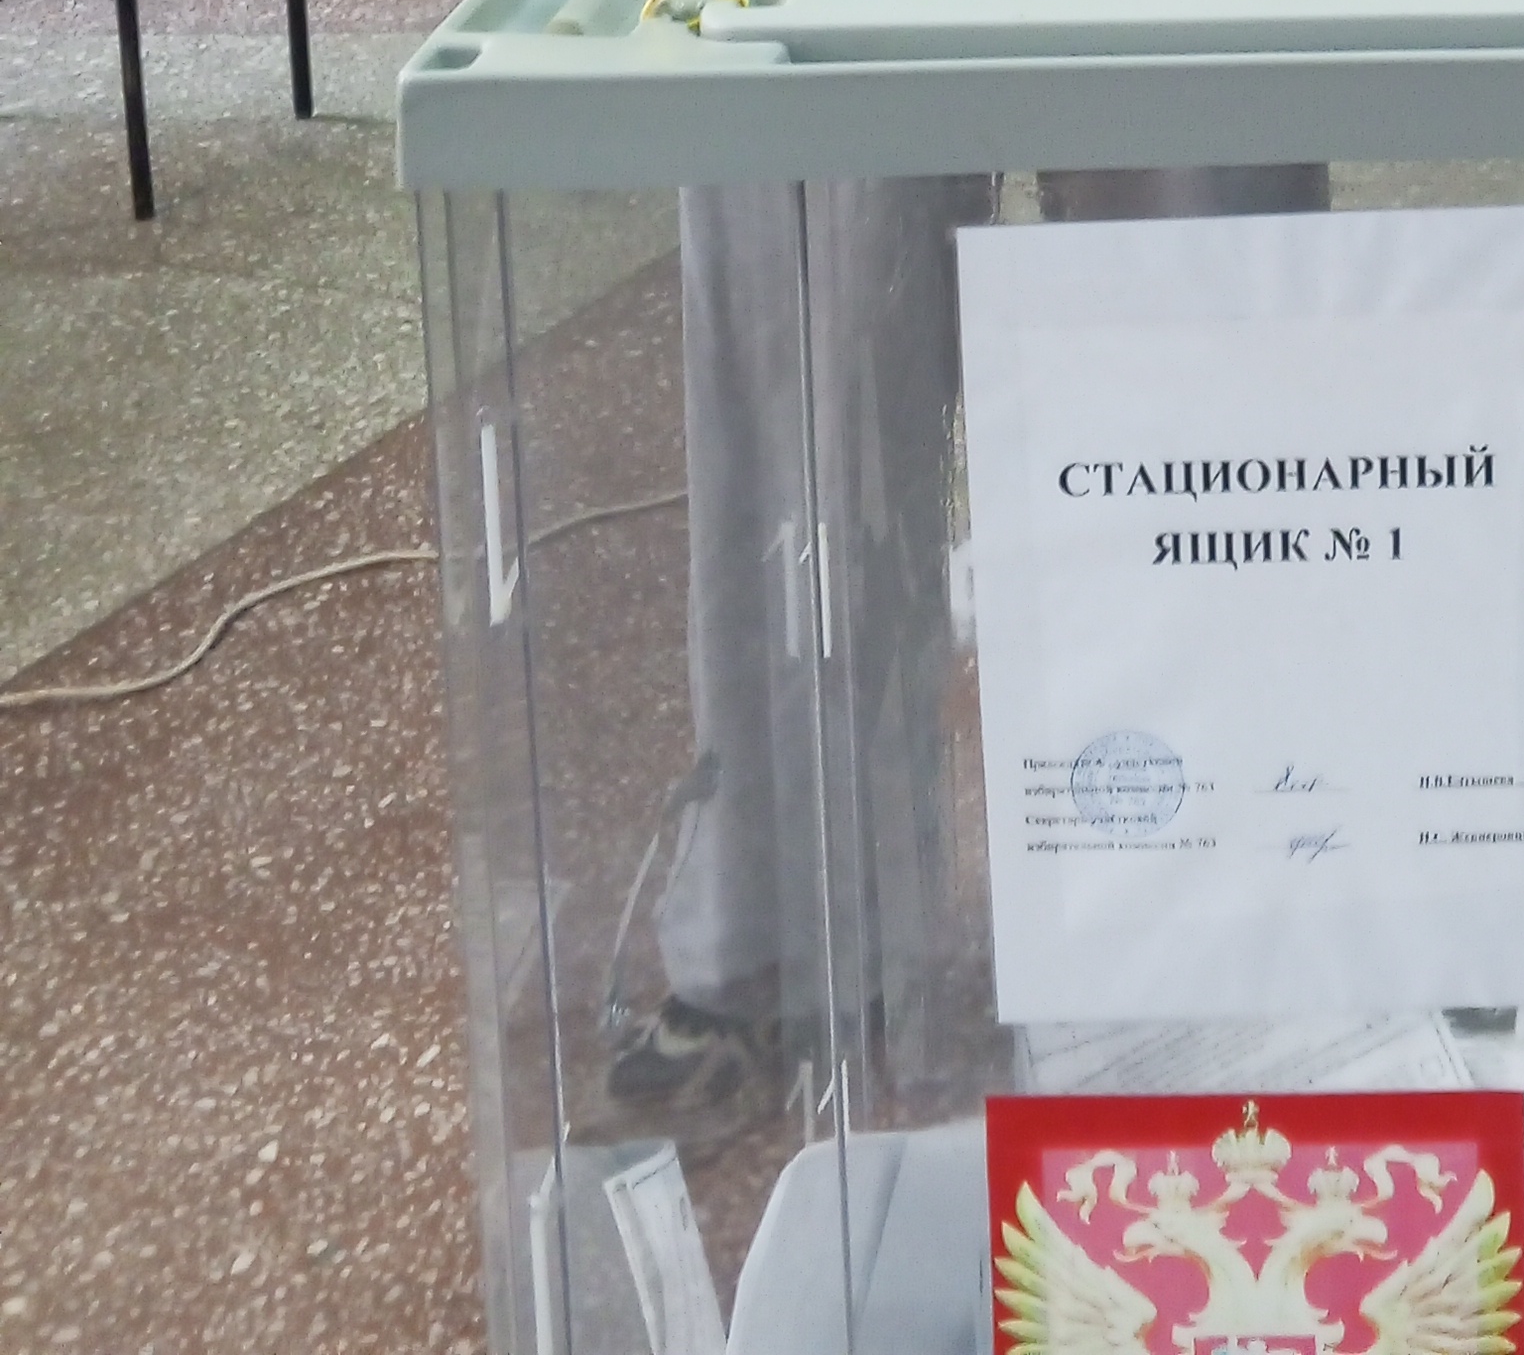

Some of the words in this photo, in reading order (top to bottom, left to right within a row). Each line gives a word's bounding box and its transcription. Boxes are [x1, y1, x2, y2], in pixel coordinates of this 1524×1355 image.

[1057, 444, 1496, 502] СТАЦИОНАРНЫЙ
[1151, 528, 1311, 571] ЯЩИК
[1323, 527, 1372, 562] №
[1388, 526, 1405, 561] 1
